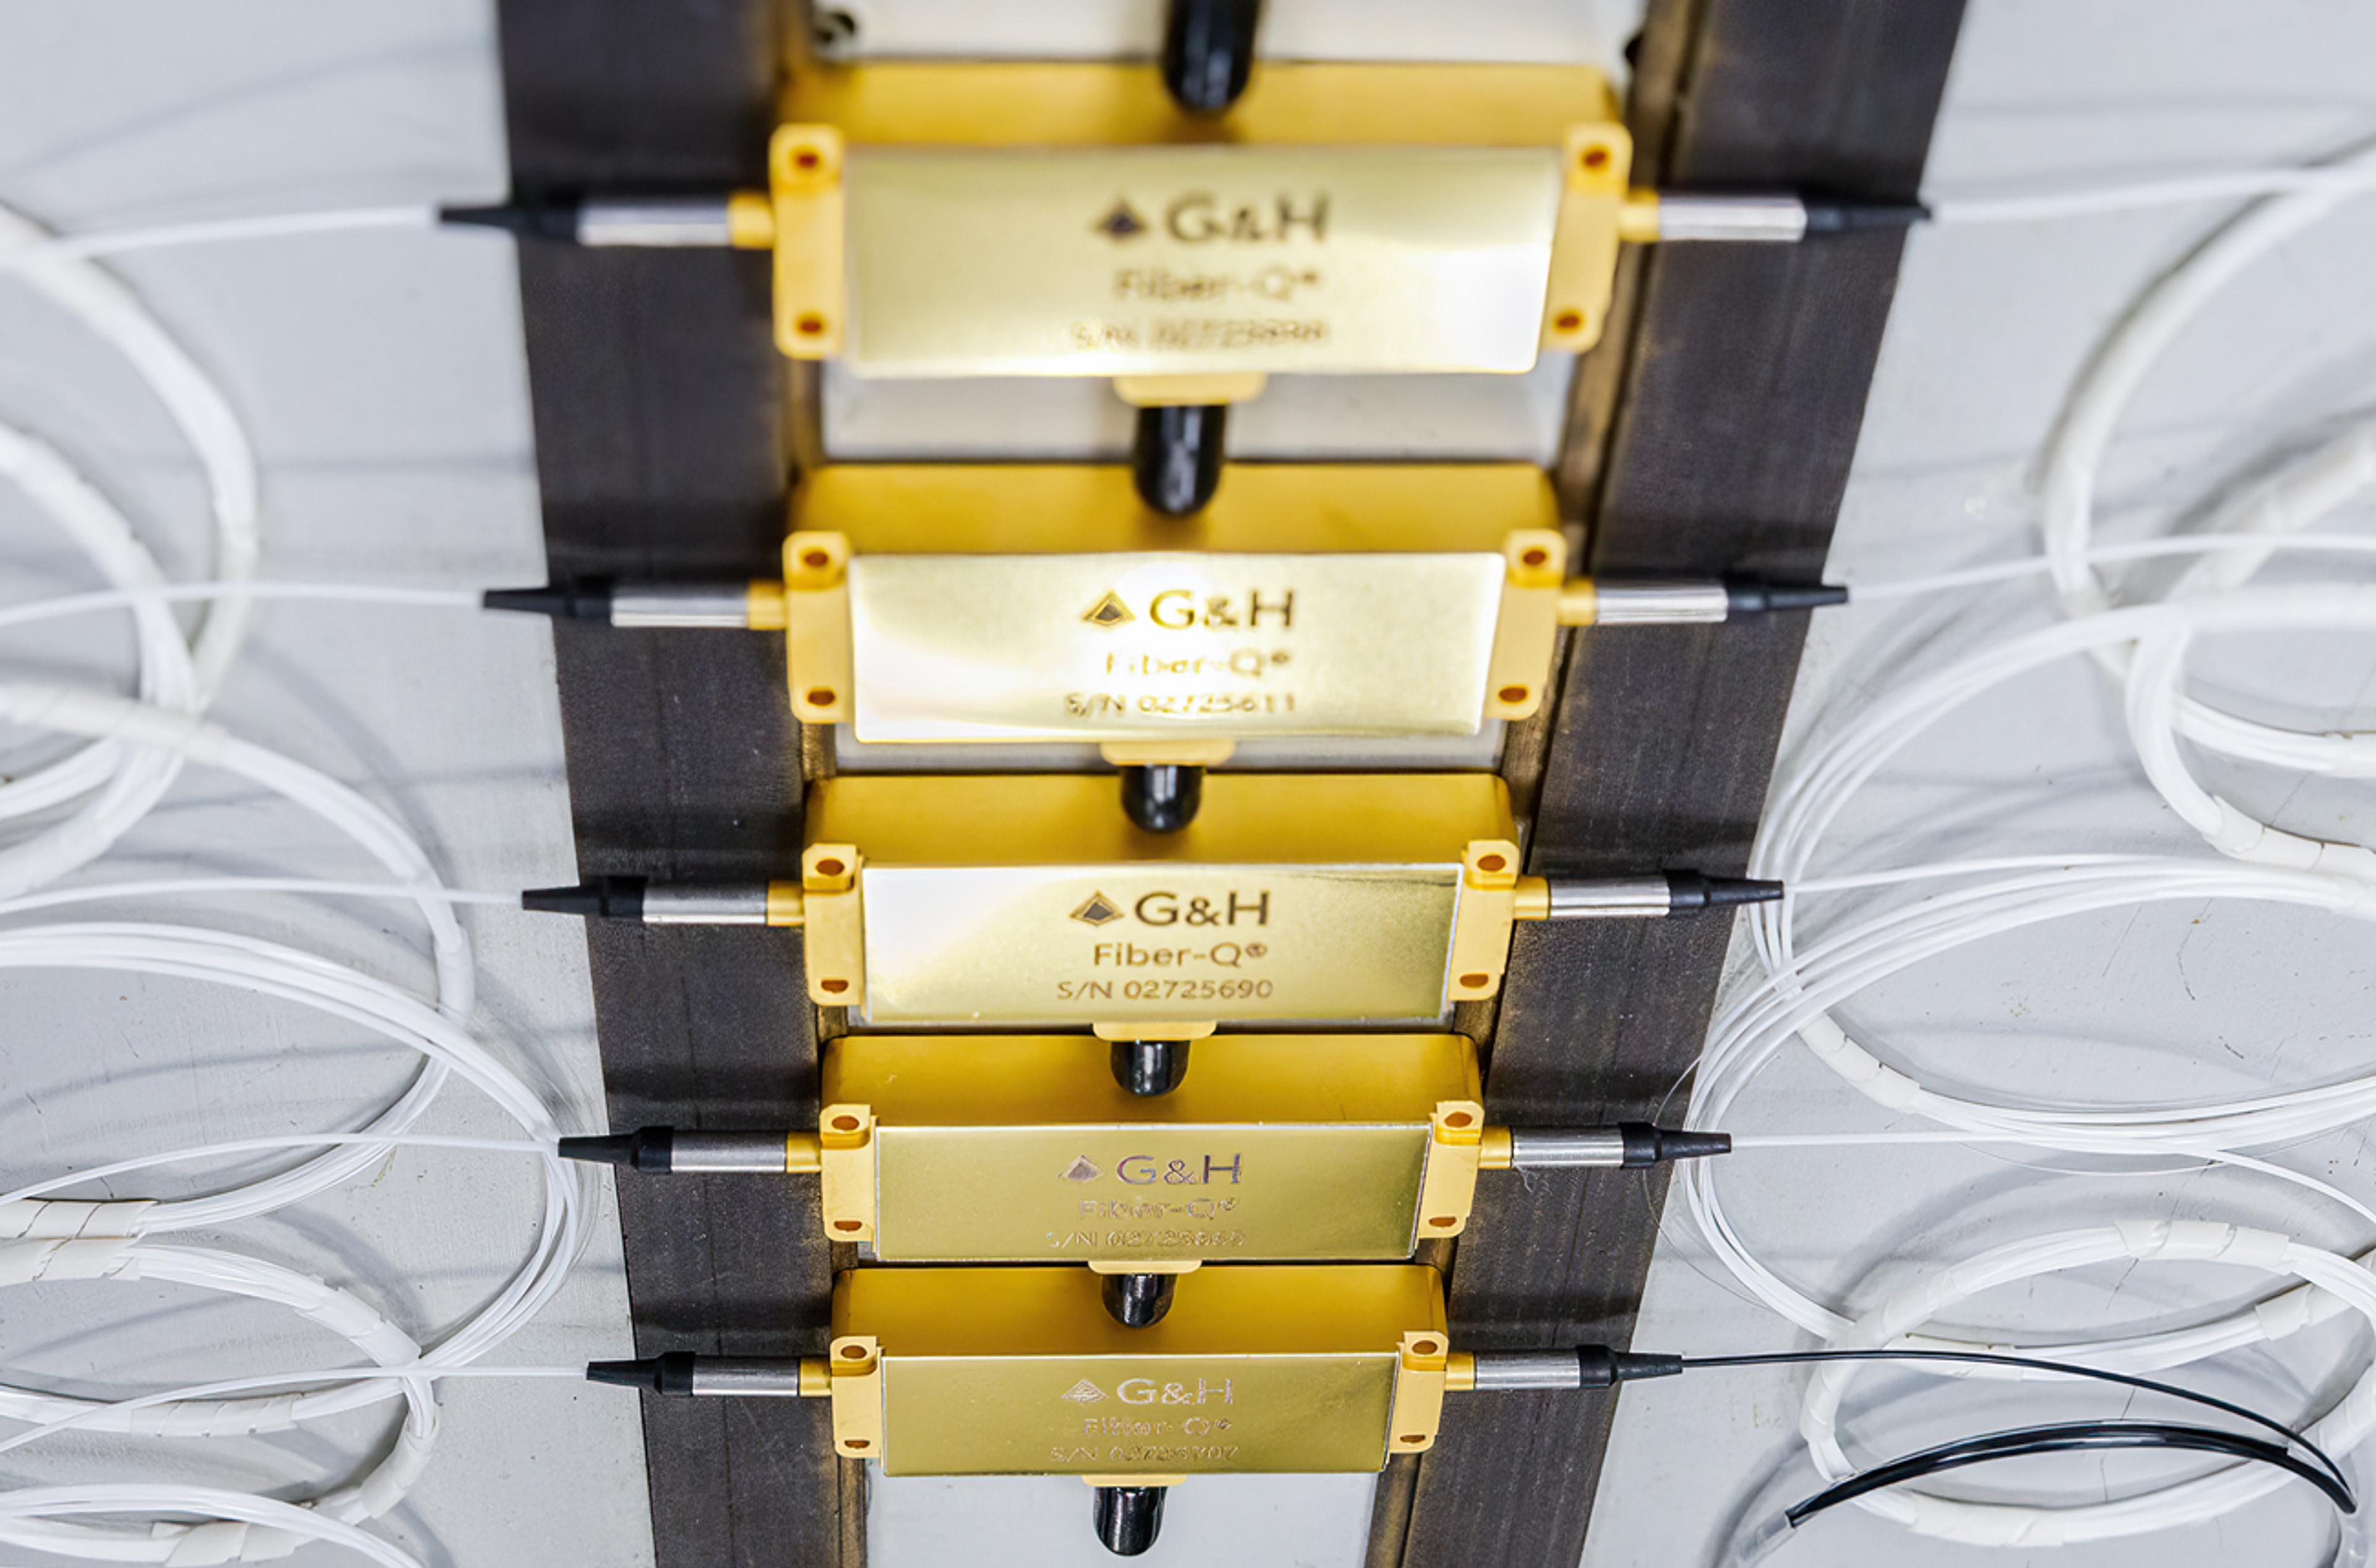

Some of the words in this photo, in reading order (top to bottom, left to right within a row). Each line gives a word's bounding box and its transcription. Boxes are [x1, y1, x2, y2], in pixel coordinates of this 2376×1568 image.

[1164, 191, 1330, 242] G&H
[1150, 589, 1294, 630] G&H
[1065, 693, 1126, 716] S/N
[1135, 890, 1270, 926] G&H
[1057, 981, 1113, 1001] S/N
[1124, 980, 1273, 999] 02725690
[1116, 1153, 1241, 1185] G&H
[1046, 1231, 1098, 1248] S/N
[1116, 1378, 1233, 1405] G&H
[1051, 1446, 1098, 1463] S/N
